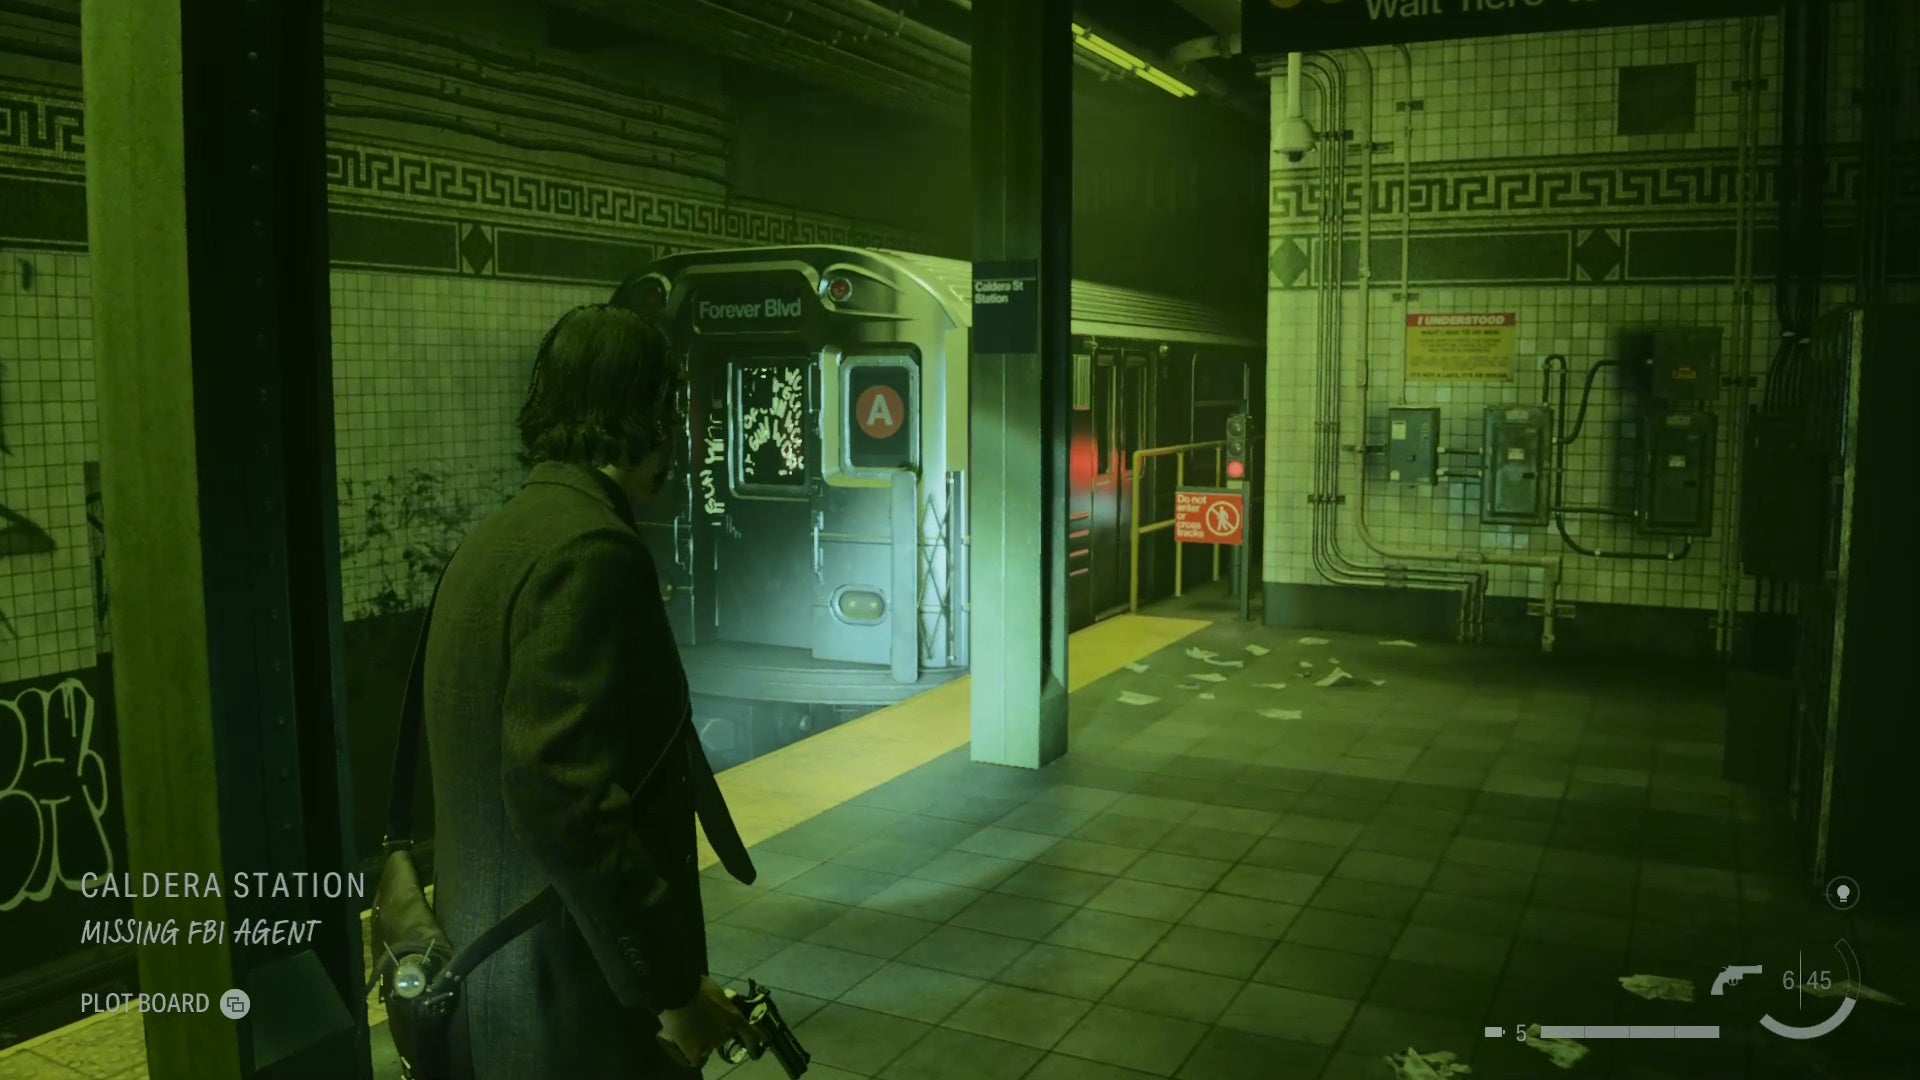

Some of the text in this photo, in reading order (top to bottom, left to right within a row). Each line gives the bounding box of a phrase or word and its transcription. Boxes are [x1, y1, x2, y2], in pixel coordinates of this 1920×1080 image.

[974, 280, 1024, 292] Caldera St
[974, 293, 1009, 304] Station
[700, 297, 802, 319] Forever Blvd
[1424, 315, 1505, 325] UNDERSTOOD
[866, 394, 893, 426] A
[1177, 494, 1207, 504] Do not
[1177, 504, 1200, 512] enter
[1176, 529, 1205, 538] tracks
